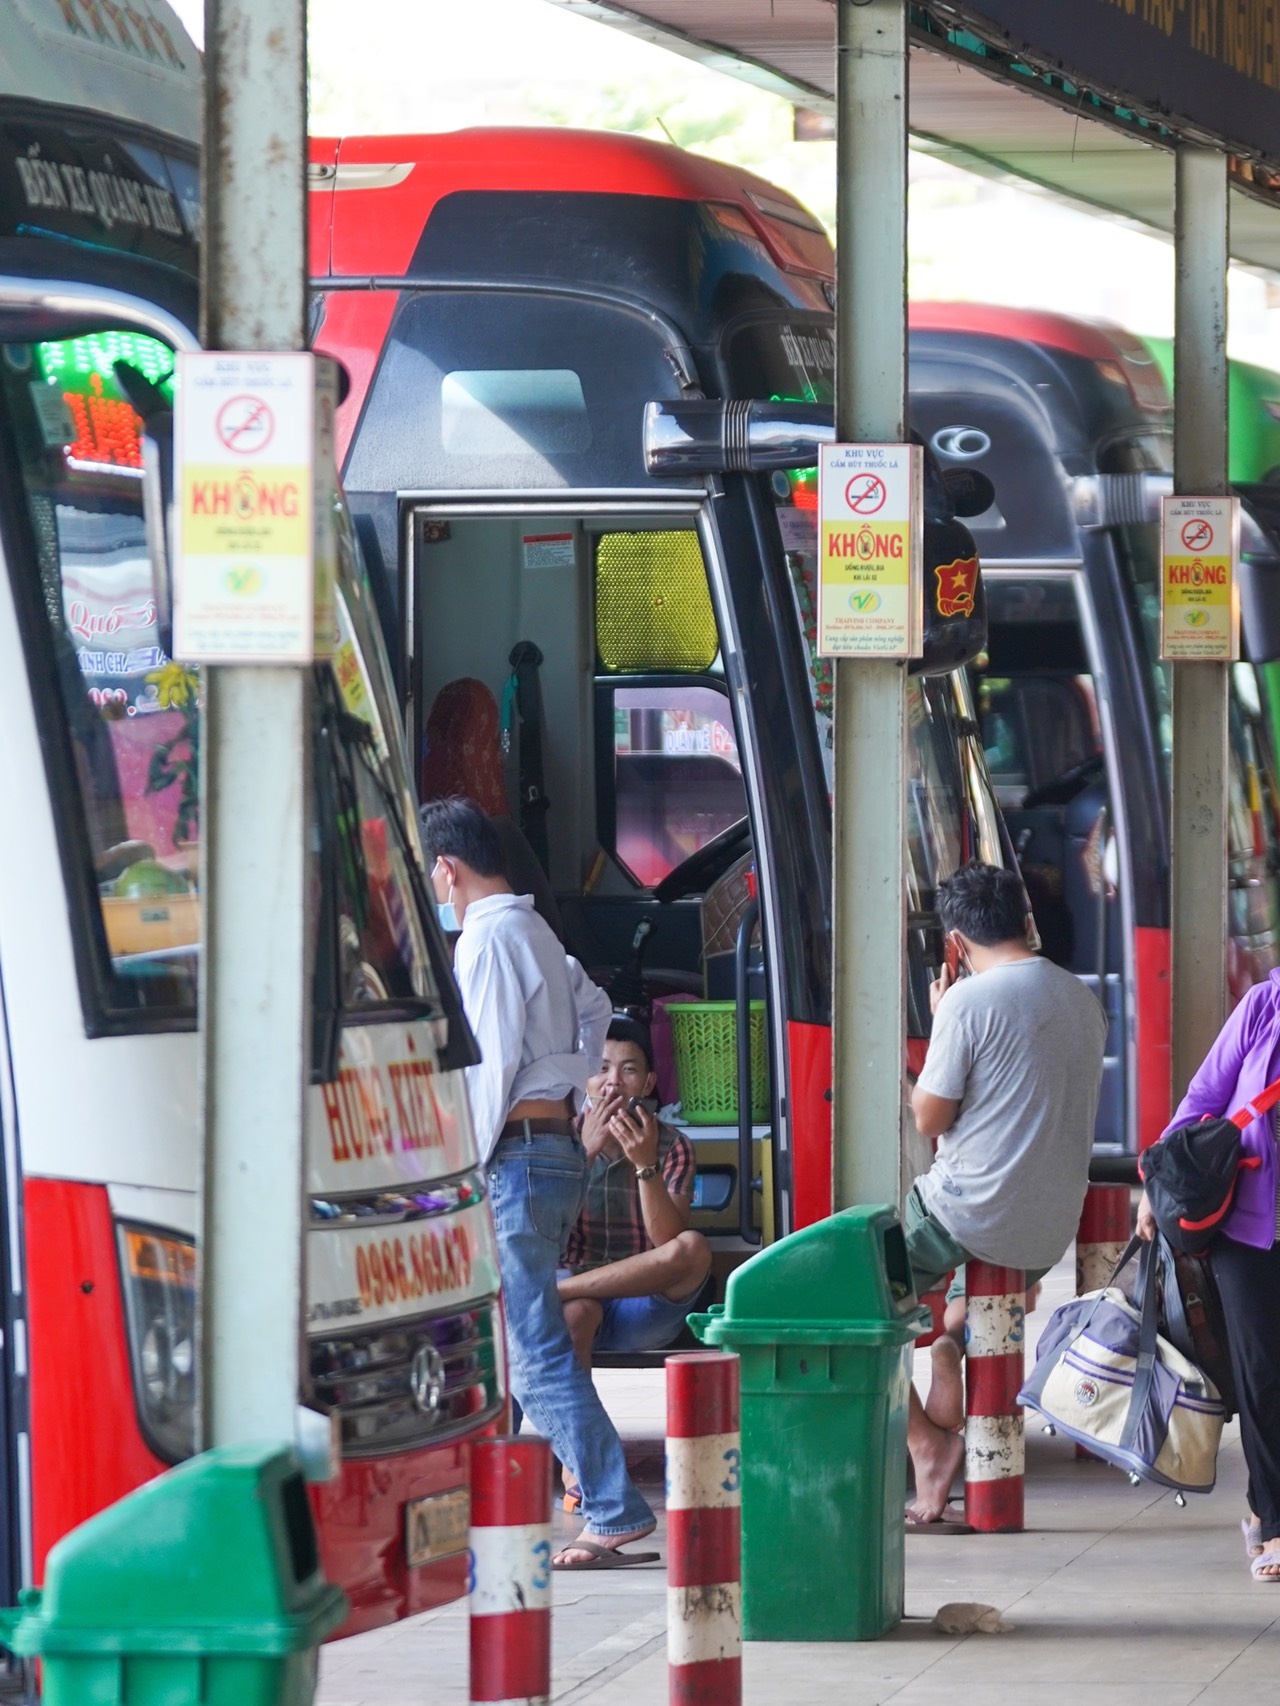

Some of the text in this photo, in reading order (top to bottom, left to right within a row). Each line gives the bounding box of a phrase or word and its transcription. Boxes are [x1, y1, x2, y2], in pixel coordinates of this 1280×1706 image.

[191, 468, 300, 520] KHÔNG
[828, 522, 904, 561] KHÔNG
[1169, 557, 1227, 586] KHÔNG
